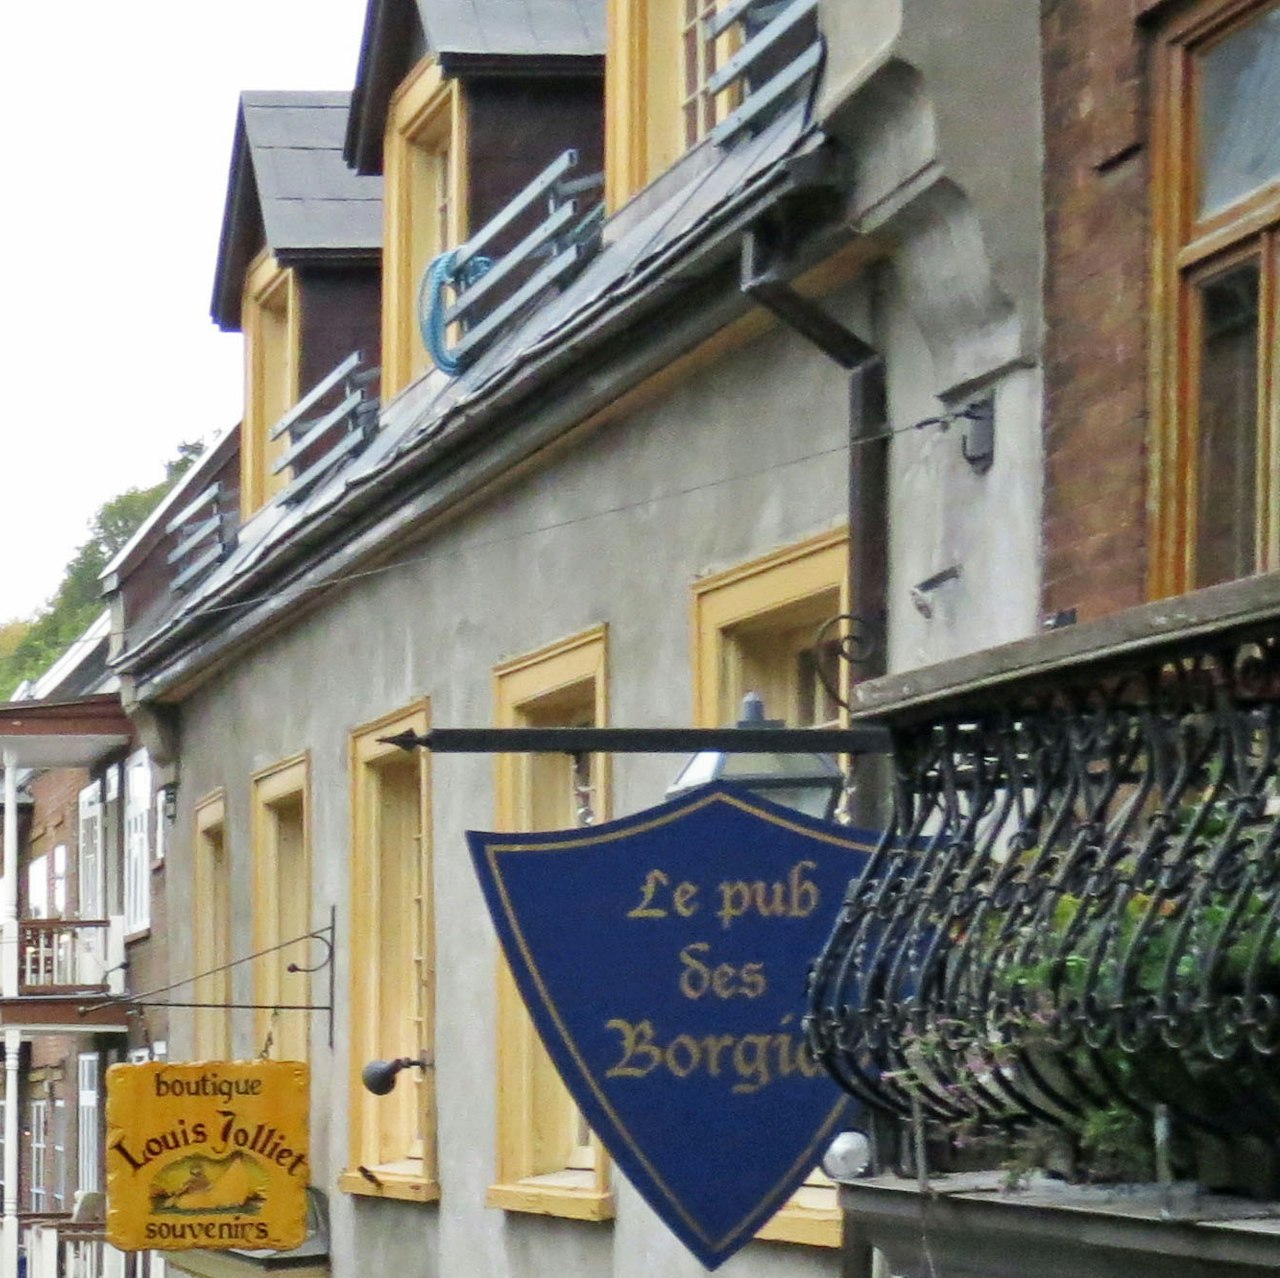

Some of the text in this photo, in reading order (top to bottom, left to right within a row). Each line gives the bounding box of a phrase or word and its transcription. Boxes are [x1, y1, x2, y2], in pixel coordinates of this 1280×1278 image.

[627, 860, 820, 929] Le pub
[680, 942, 767, 1000] des
[606, 1014, 870, 1094] Borgia
[155, 1072, 262, 1104] boutique
[111, 1109, 309, 1177] Louis Jolliet
[145, 1216, 269, 1242] souvenirs
